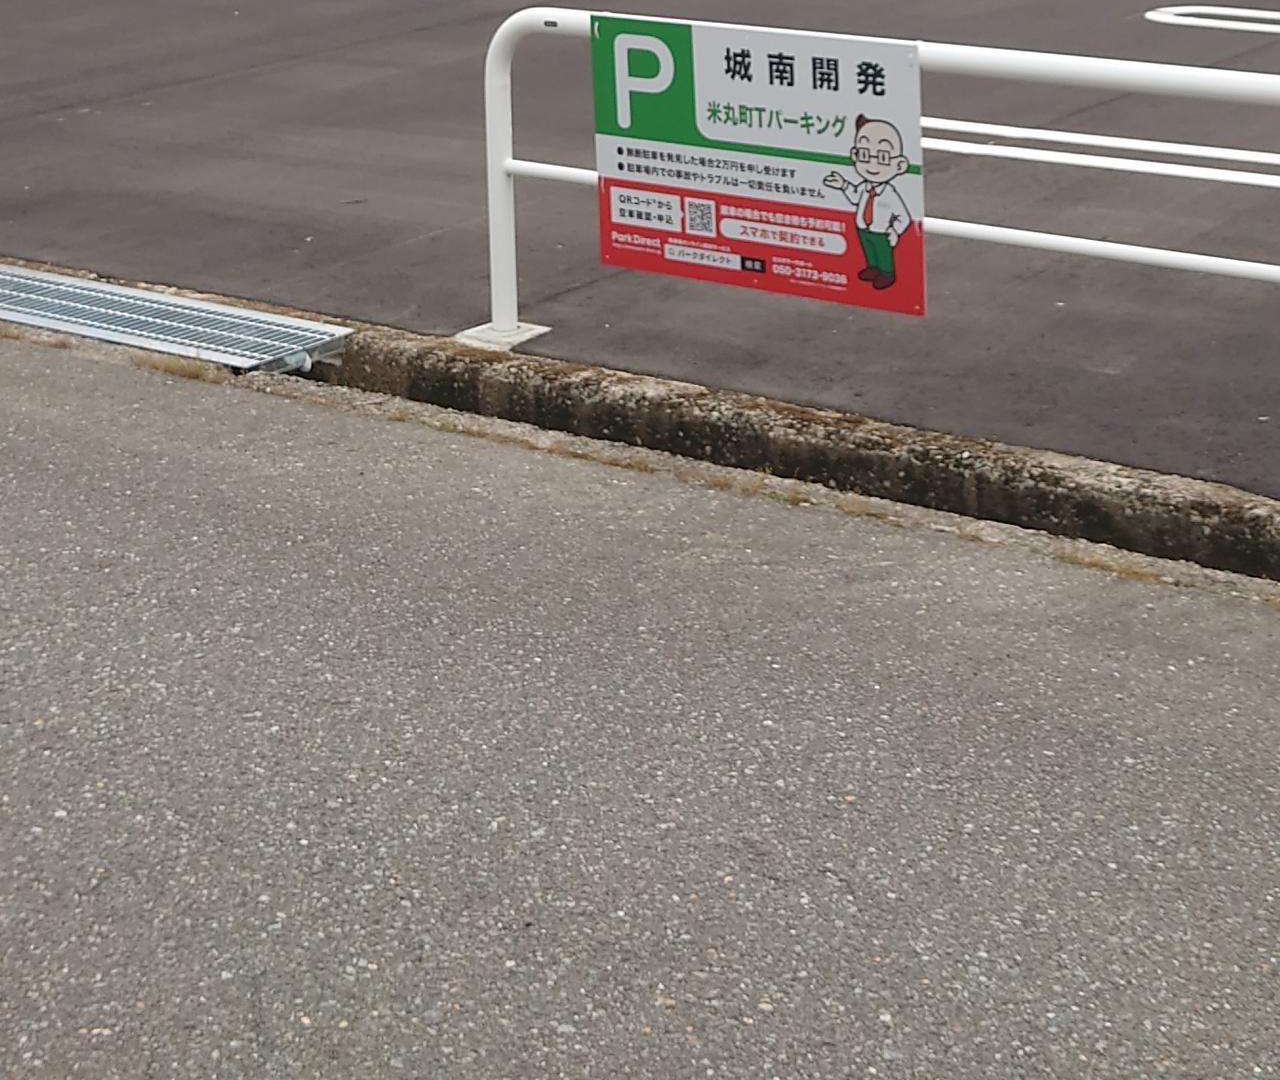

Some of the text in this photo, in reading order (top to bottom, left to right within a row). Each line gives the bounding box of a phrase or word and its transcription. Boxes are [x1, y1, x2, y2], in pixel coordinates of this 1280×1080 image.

[613, 33, 675, 130] P
[724, 47, 886, 97] 城南開発
[706, 101, 848, 138] 米丸町Tパーキング
